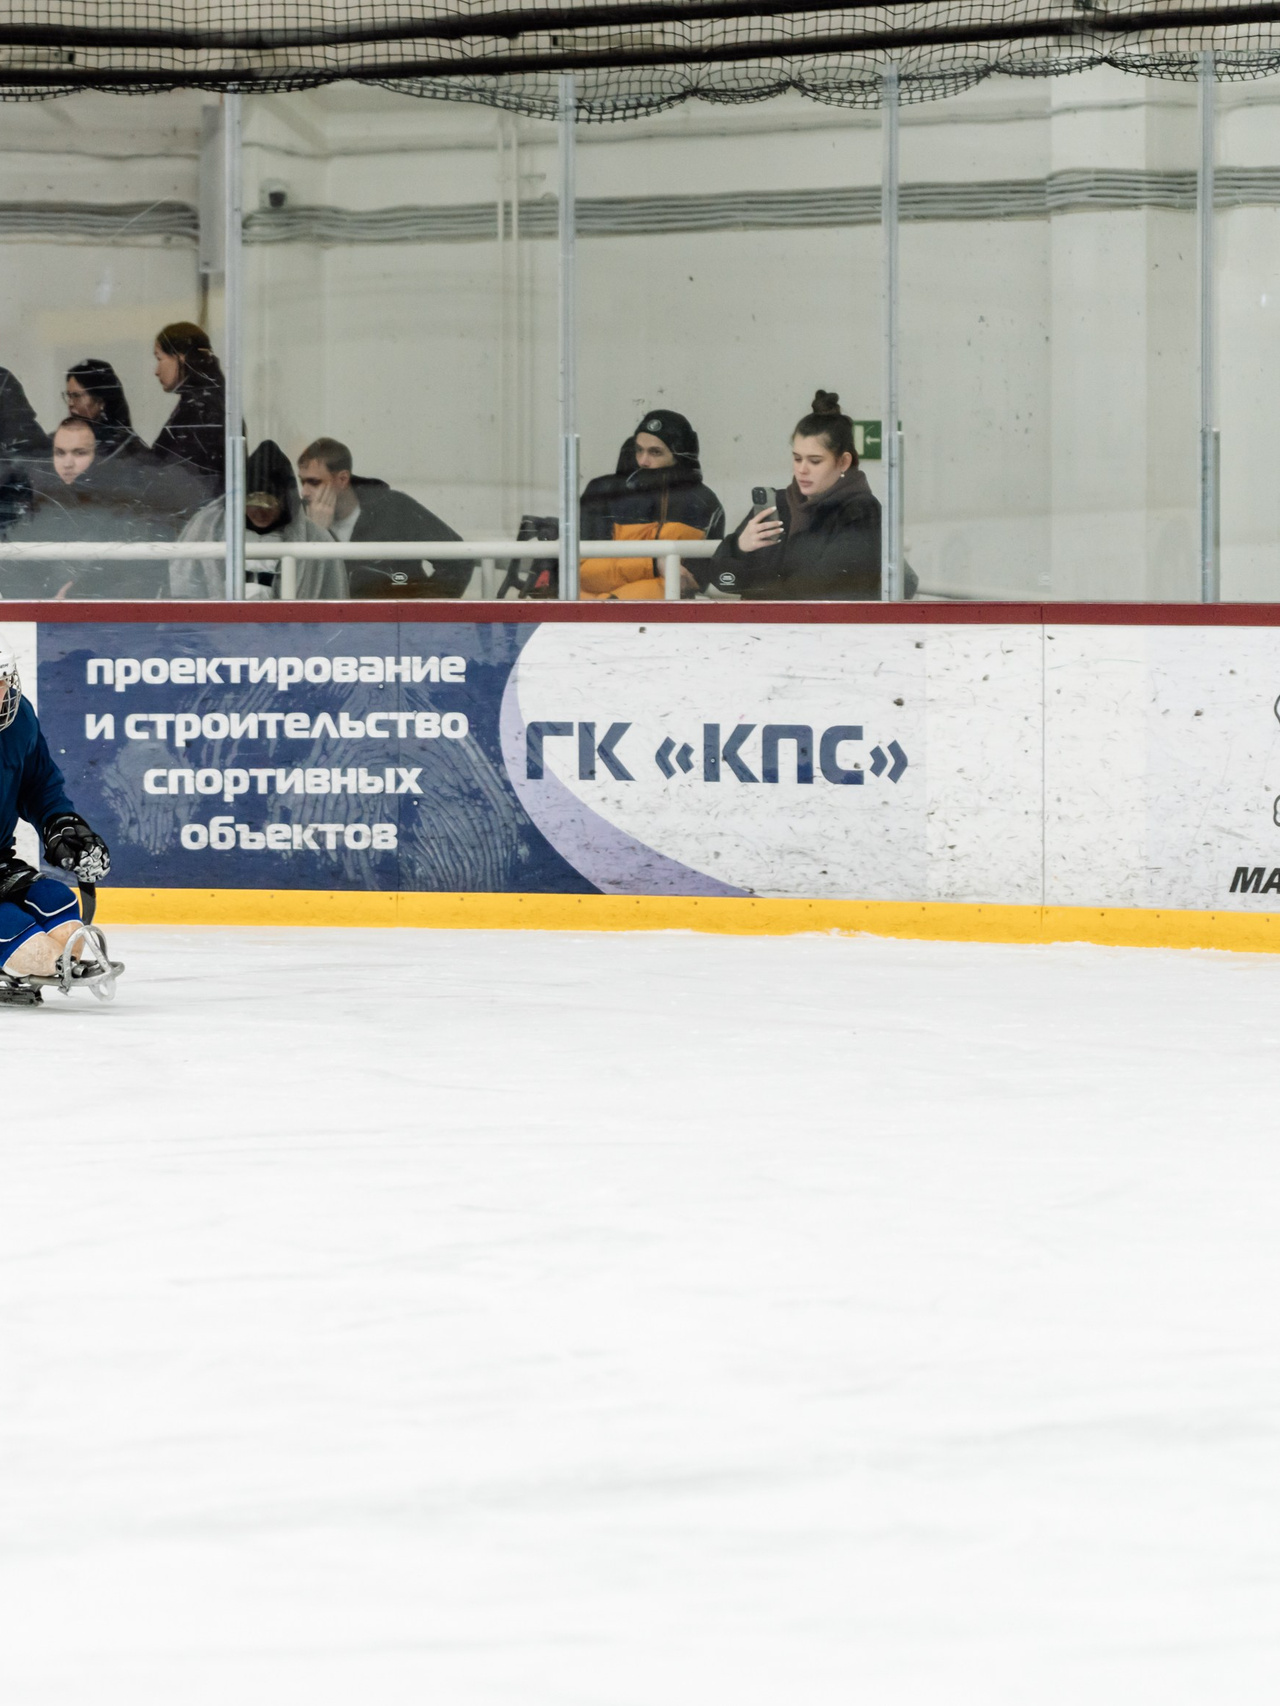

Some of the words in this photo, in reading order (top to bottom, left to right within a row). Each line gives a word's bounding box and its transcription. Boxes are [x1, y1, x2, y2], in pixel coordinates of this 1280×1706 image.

[86, 656, 466, 692] проектирование
[85, 713, 115, 740] и
[124, 712, 469, 747] строительство
[525, 721, 634, 781] ГК
[655, 723, 908, 785] «КПС»
[143, 767, 423, 803] спортивных
[180, 816, 398, 850] объектов
